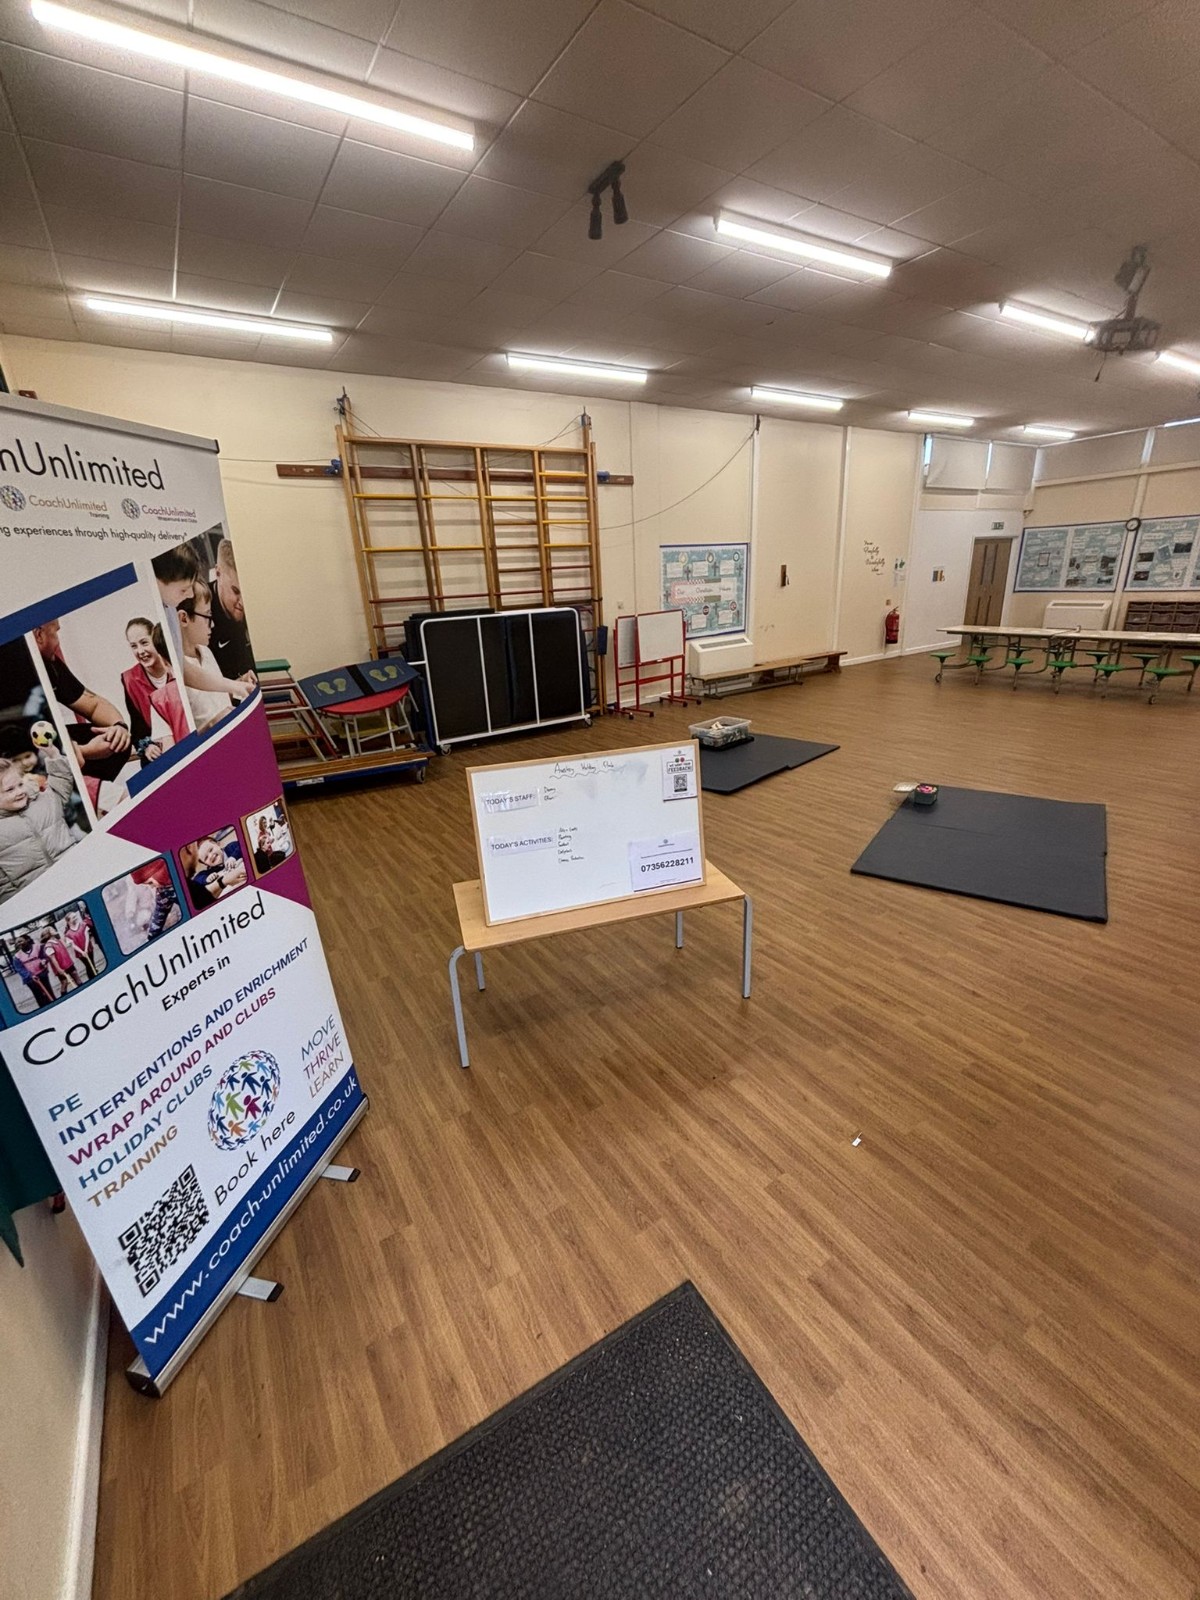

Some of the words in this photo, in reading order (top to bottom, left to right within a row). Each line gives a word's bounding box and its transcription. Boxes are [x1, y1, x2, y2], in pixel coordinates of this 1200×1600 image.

[28, 494, 108, 512] CoachUnlimited
[141, 504, 197, 518] CoachUnlimited
[13, 525, 73, 538] experiences
[74, 526, 109, 541] through
[109, 528, 156, 542] high-quality
[486, 796, 513, 805] TODAYS
[640, 856, 694, 873] 07356228211
[22, 891, 265, 1066] CoachUnlimited
[162, 966, 216, 1011] Experts
[217, 955, 231, 971] in
[58, 1023, 202, 1146] INTERVENTIONS
[205, 998, 234, 1030] AND
[235, 938, 308, 1004] ENRICHMENT
[301, 1014, 335, 1062] MOVE
[303, 1031, 341, 1079] THRIVE
[67, 1111, 135, 1167] WRAP
[139, 1049, 202, 1116] AROUND
[205, 1022, 233, 1054] AND
[235, 987, 276, 1026] CLUBS
[309, 1051, 344, 1099] LEARN
[48, 1093, 83, 1123] PE
[78, 1110, 163, 1190] HOLIDAY
[166, 1064, 213, 1114] CLUBS
[87, 1124, 178, 1208] TRAINING
[214, 1149, 259, 1206] Book
[260, 1110, 296, 1152] here
[144, 1076, 357, 1344] www.coach-unlimited.co.uk
